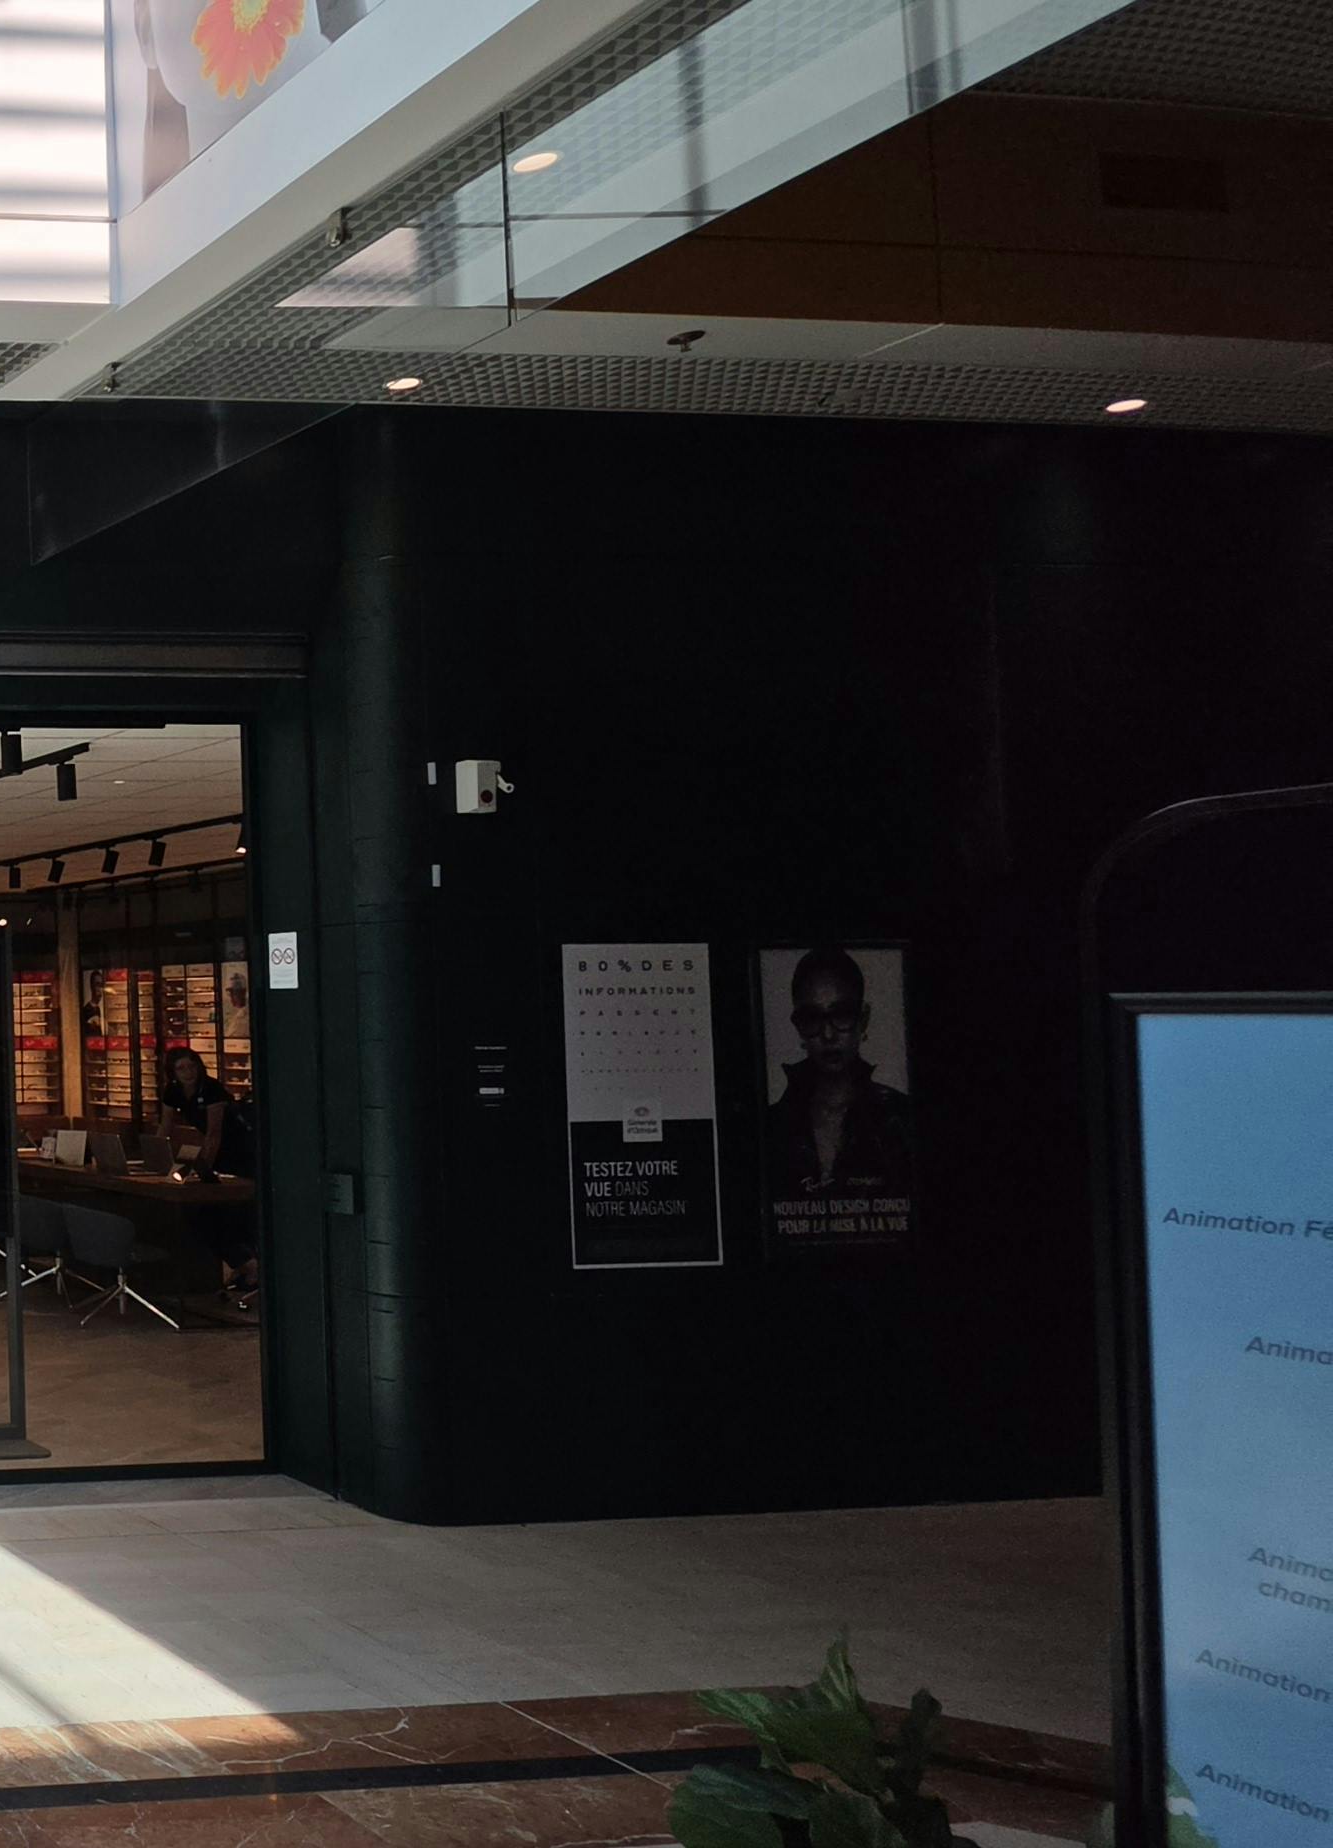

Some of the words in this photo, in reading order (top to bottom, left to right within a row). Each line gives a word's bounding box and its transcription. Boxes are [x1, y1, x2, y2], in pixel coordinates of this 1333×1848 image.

[579, 987, 695, 996] INFORMATIONS
[584, 1161, 633, 1178] TESTEZ
[635, 1160, 679, 1176] VOTRE
[584, 1182, 612, 1198] VUE
[614, 1181, 650, 1197] DANS
[585, 1201, 626, 1217] NOTRE
[773, 1199, 826, 1216] NOUVEAU
[829, 1199, 869, 1214] DESIGN
[778, 1218, 810, 1234] POUR
[1162, 1207, 1296, 1237] Animation
[1195, 1648, 1333, 1705] Animation
[1196, 1763, 1330, 1823] Animation
